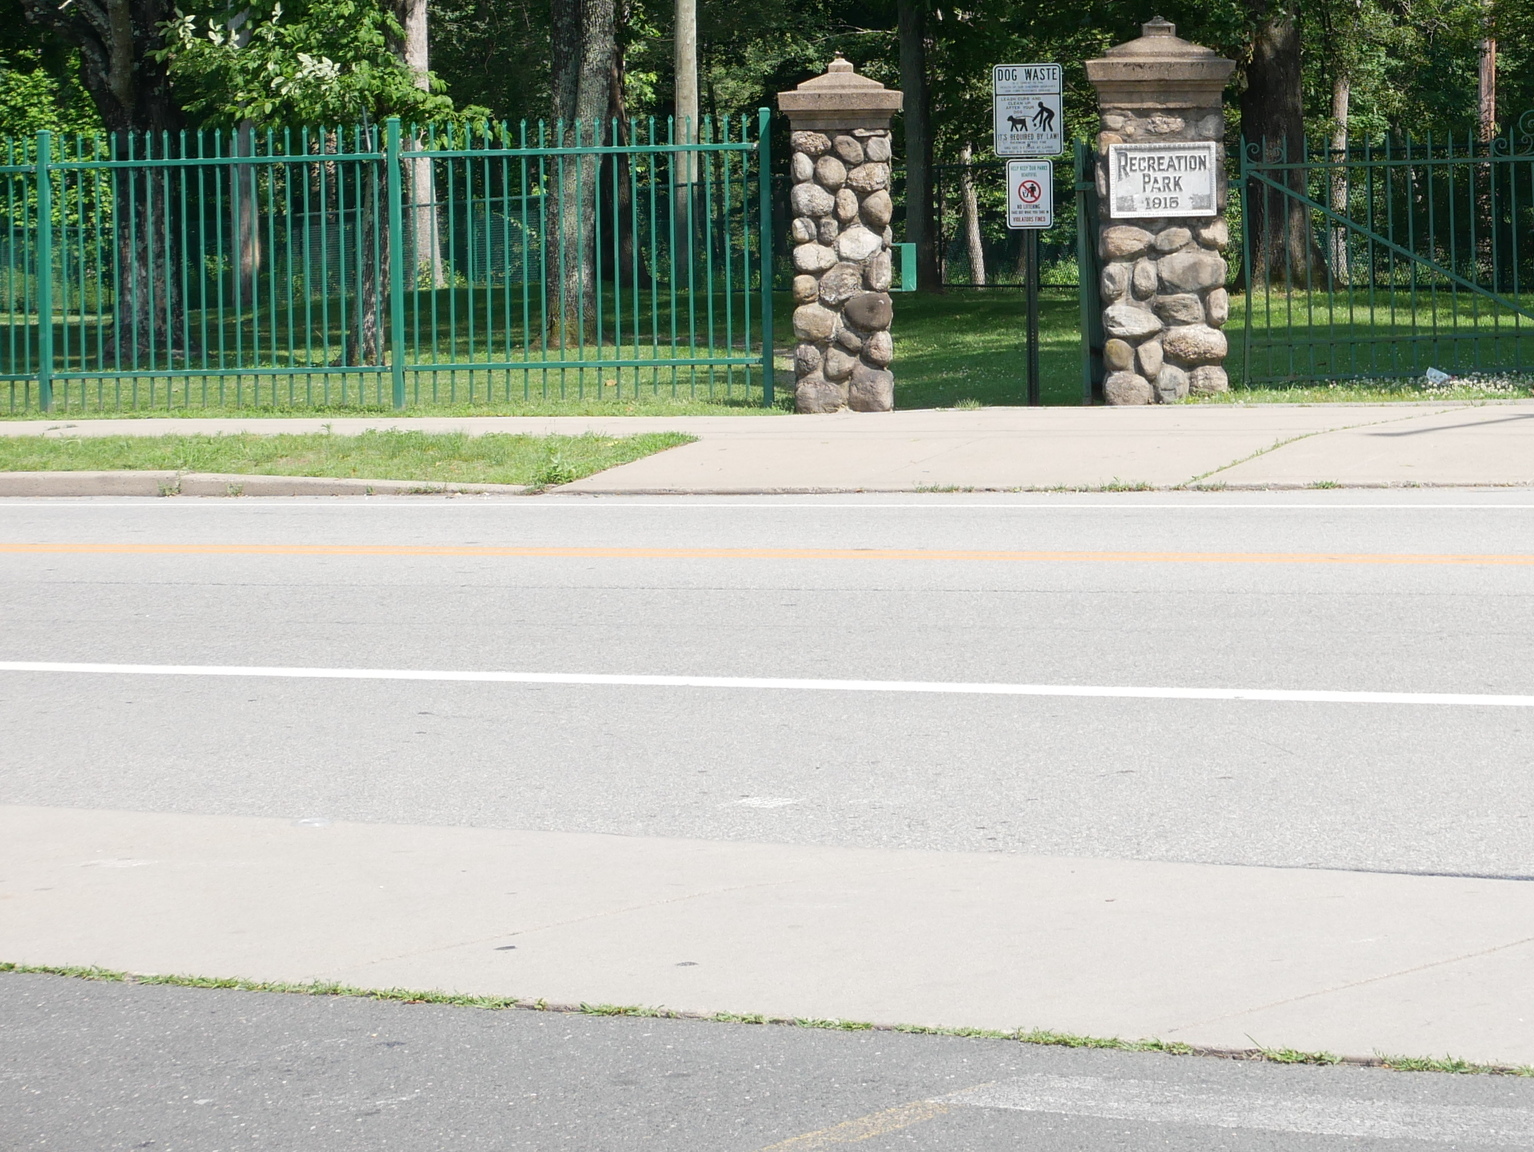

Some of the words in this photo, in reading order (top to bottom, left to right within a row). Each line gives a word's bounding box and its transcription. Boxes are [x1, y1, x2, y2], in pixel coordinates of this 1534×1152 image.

[997, 69, 1018, 82] DOG
[1025, 68, 1058, 81] WASTE
[1010, 133, 1035, 141] REQUIRED
[1116, 151, 1207, 182] RECREATION
[1142, 173, 1184, 192] PARK
[1145, 196, 1179, 209] 1915
